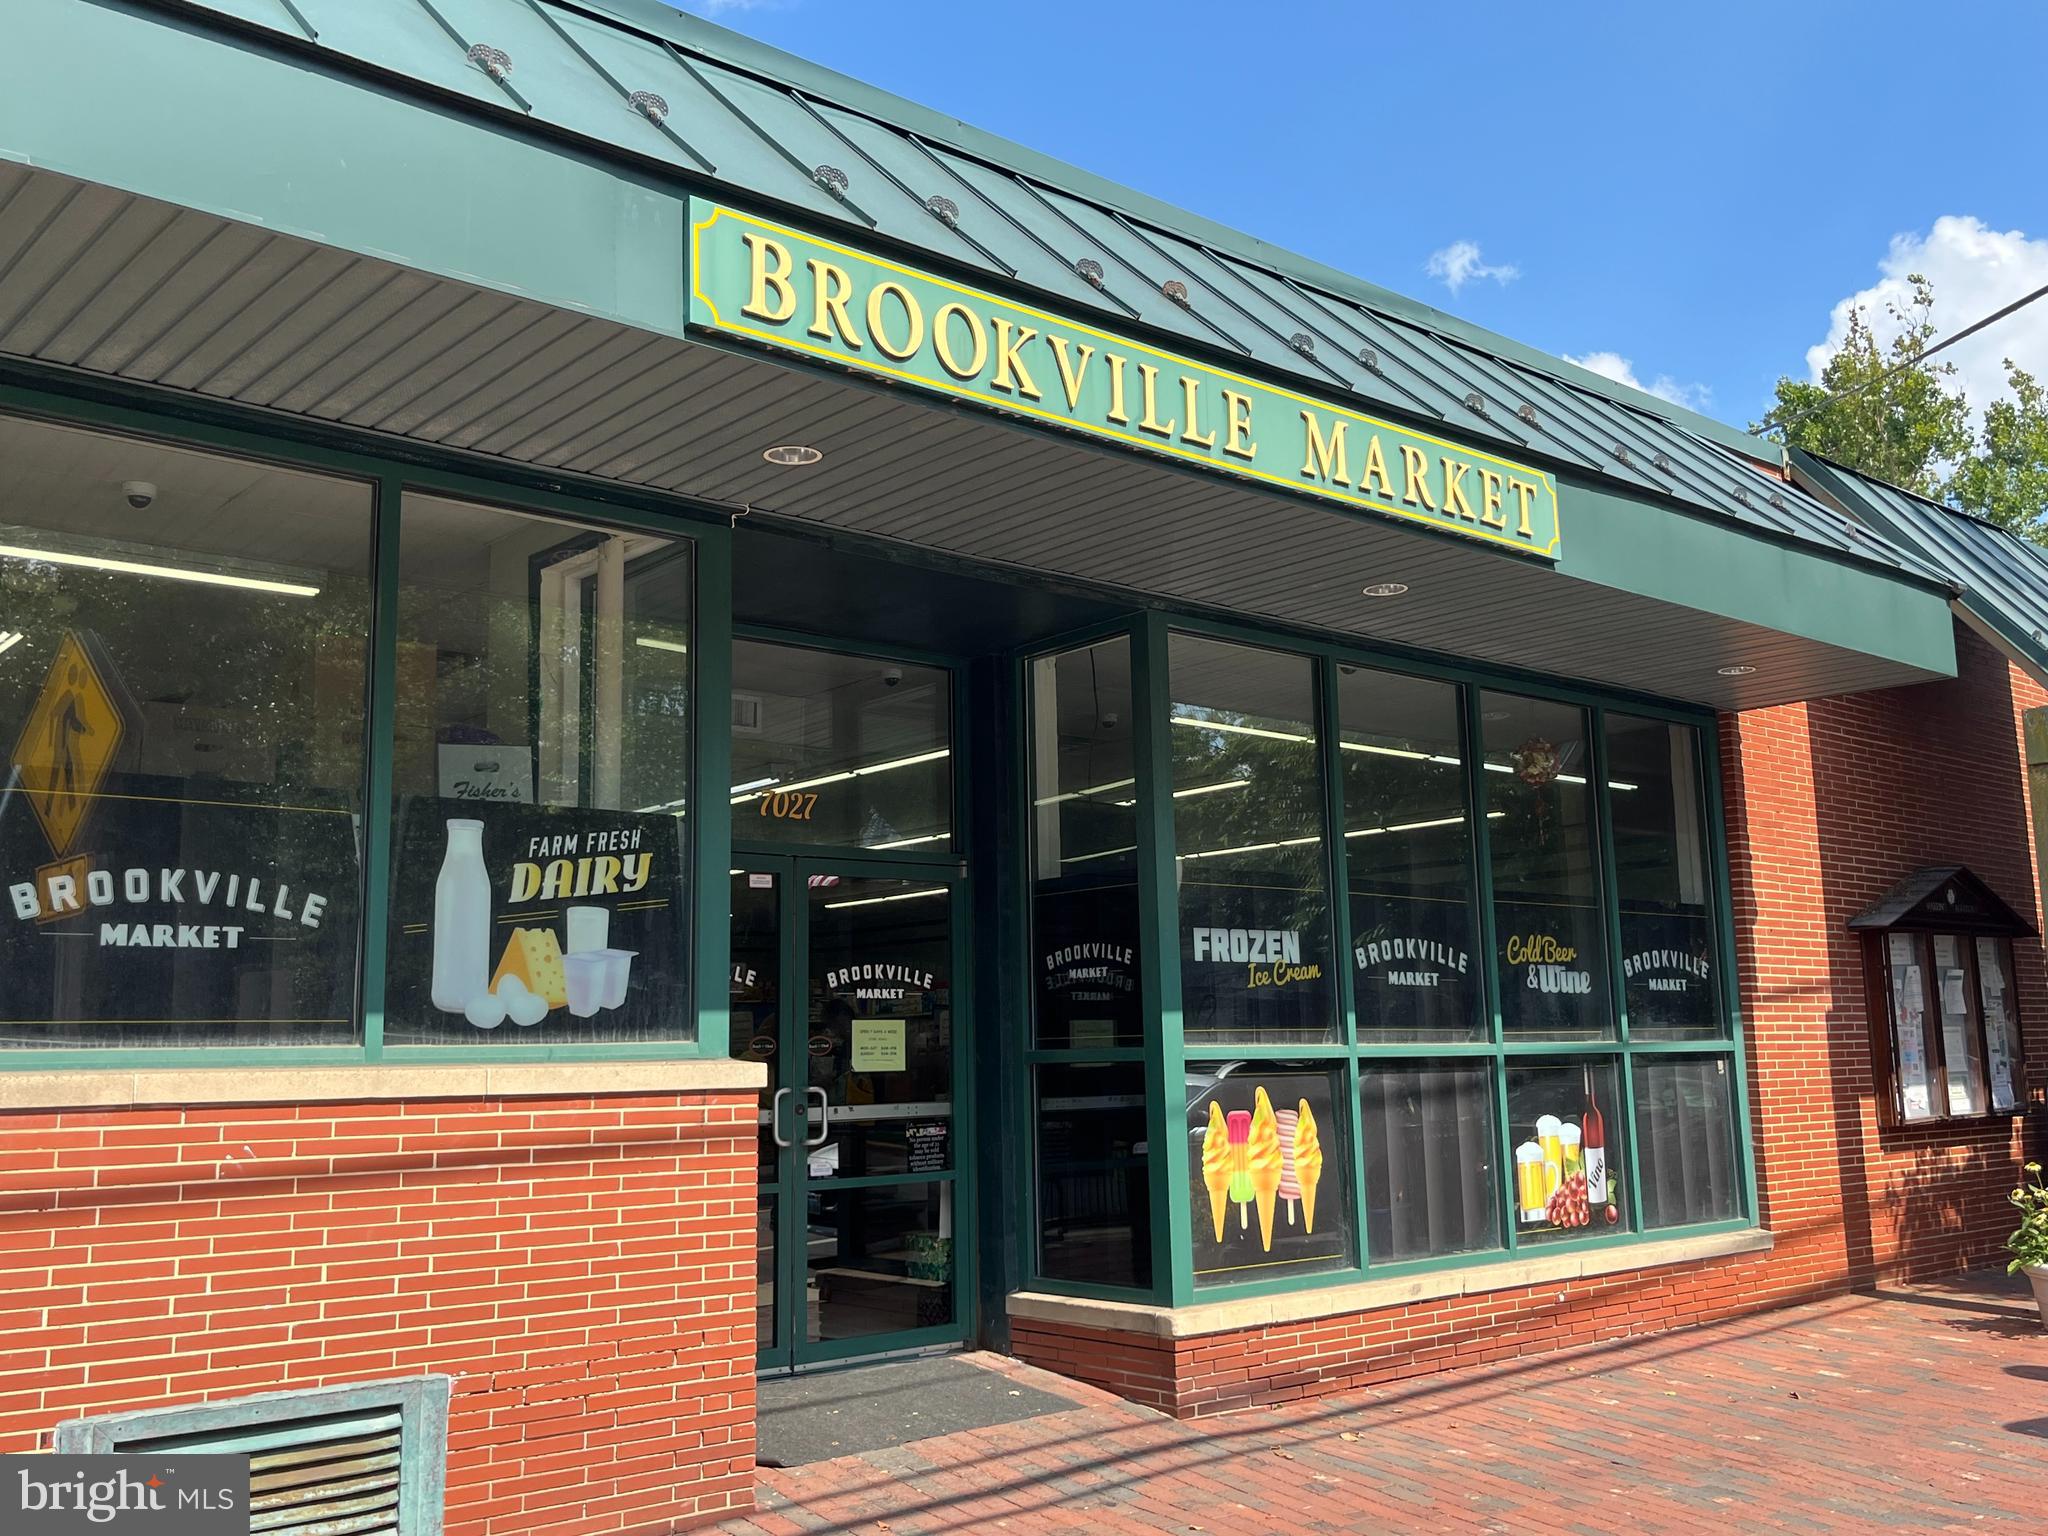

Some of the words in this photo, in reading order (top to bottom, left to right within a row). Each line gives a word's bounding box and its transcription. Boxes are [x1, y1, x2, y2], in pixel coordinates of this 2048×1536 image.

[742, 232, 1258, 460] BROOKVILLE
[1300, 410, 1538, 538] MARKET
[453, 781, 521, 799] Fisher's
[760, 789, 819, 820] 7027
[528, 833, 578, 858] FARM
[586, 829, 641, 853] FRESH
[508, 852, 654, 904] DAIRY
[9, 867, 328, 929] BROOKVILLE
[100, 923, 245, 949] MARKET
[1193, 927, 1300, 964] FROZEN
[1506, 934, 1543, 965] Cold
[1542, 936, 1578, 964] Beer
[1046, 942, 1133, 970] BROOKVILLE
[1355, 937, 1469, 975] BROOKVILLE
[1623, 948, 1710, 980] BROOKVILLE
[826, 964, 933, 989] BROOKVILLE
[1068, 966, 1109, 979] MARKET
[1247, 962, 1271, 988] Ice
[1273, 959, 1322, 986] Cream
[1388, 970, 1440, 987] MARKET
[1648, 978, 1687, 992] MARKET
[856, 988, 905, 999] MARKET
[1588, 1158, 1604, 1189] Vino
